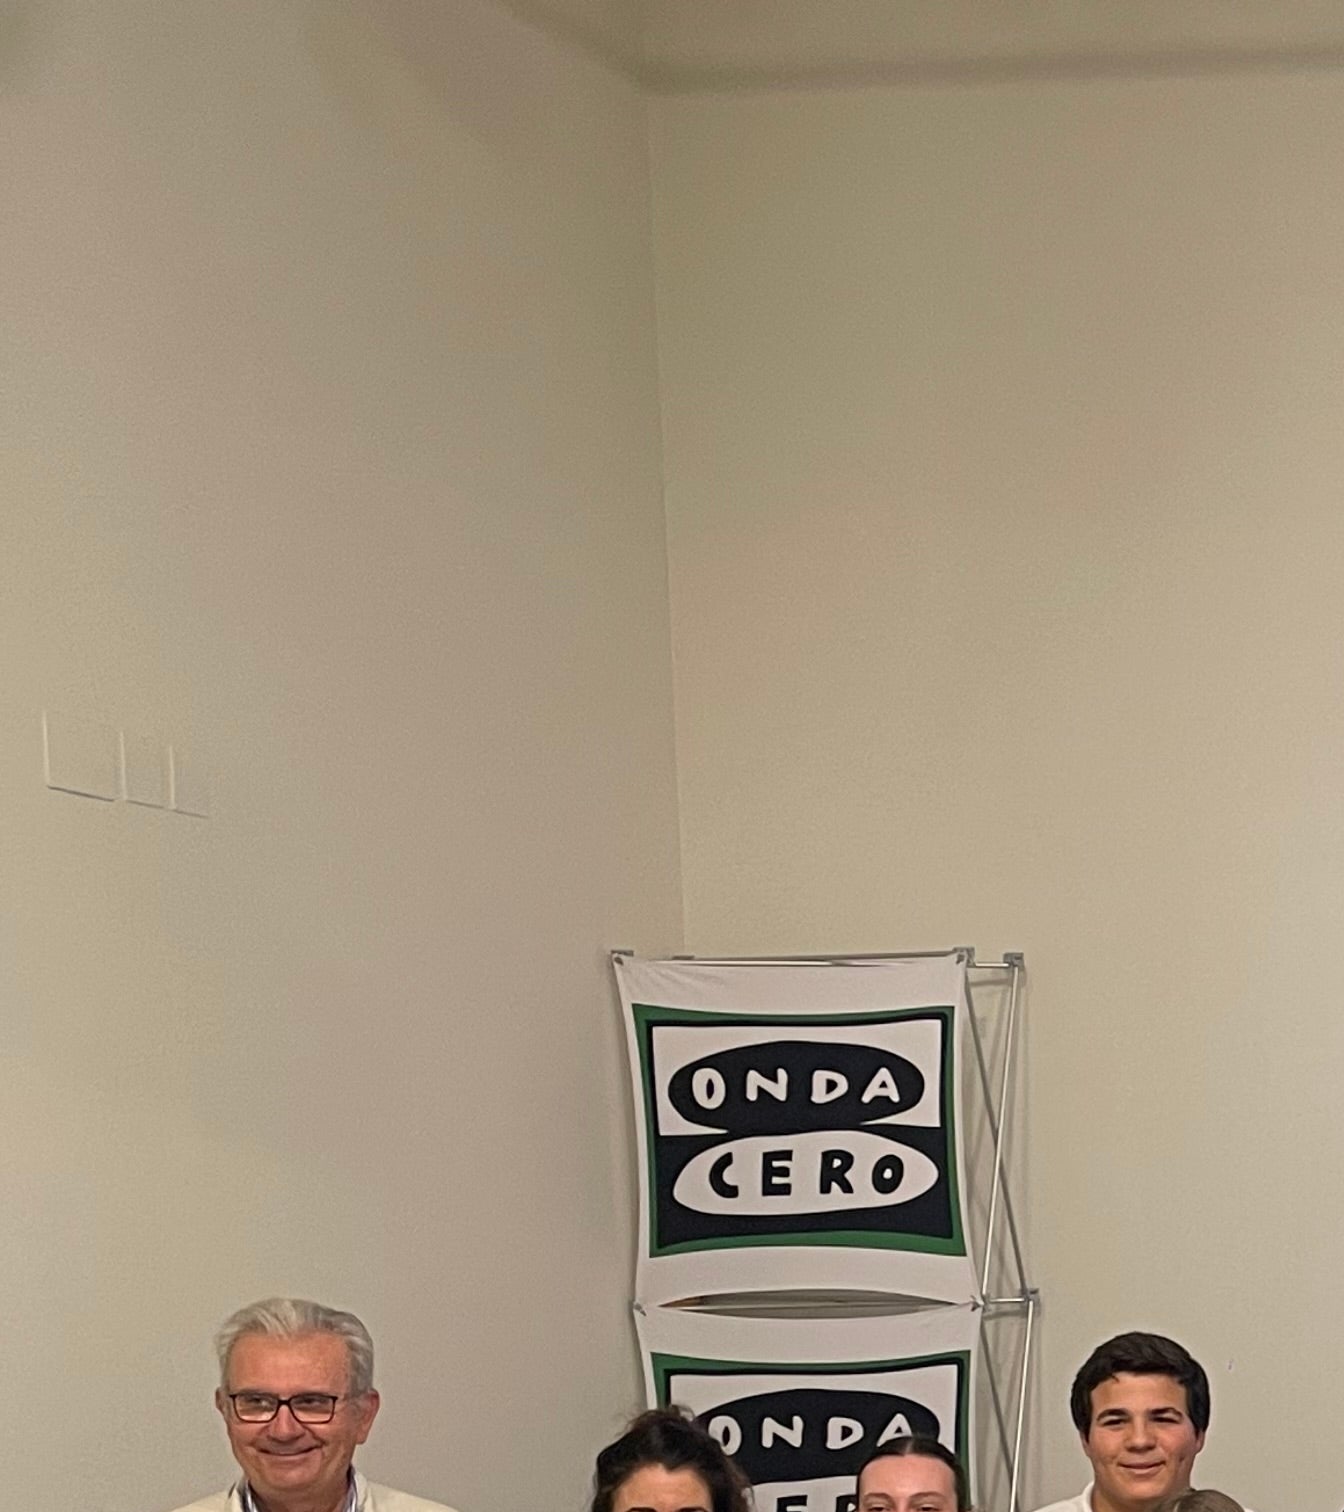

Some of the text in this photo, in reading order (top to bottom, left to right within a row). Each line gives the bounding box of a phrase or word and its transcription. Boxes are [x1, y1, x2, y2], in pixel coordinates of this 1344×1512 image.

[692, 1067, 900, 1110] ONDA
[708, 1149, 904, 1199] CERO
[707, 1412, 913, 1457] ONDA
